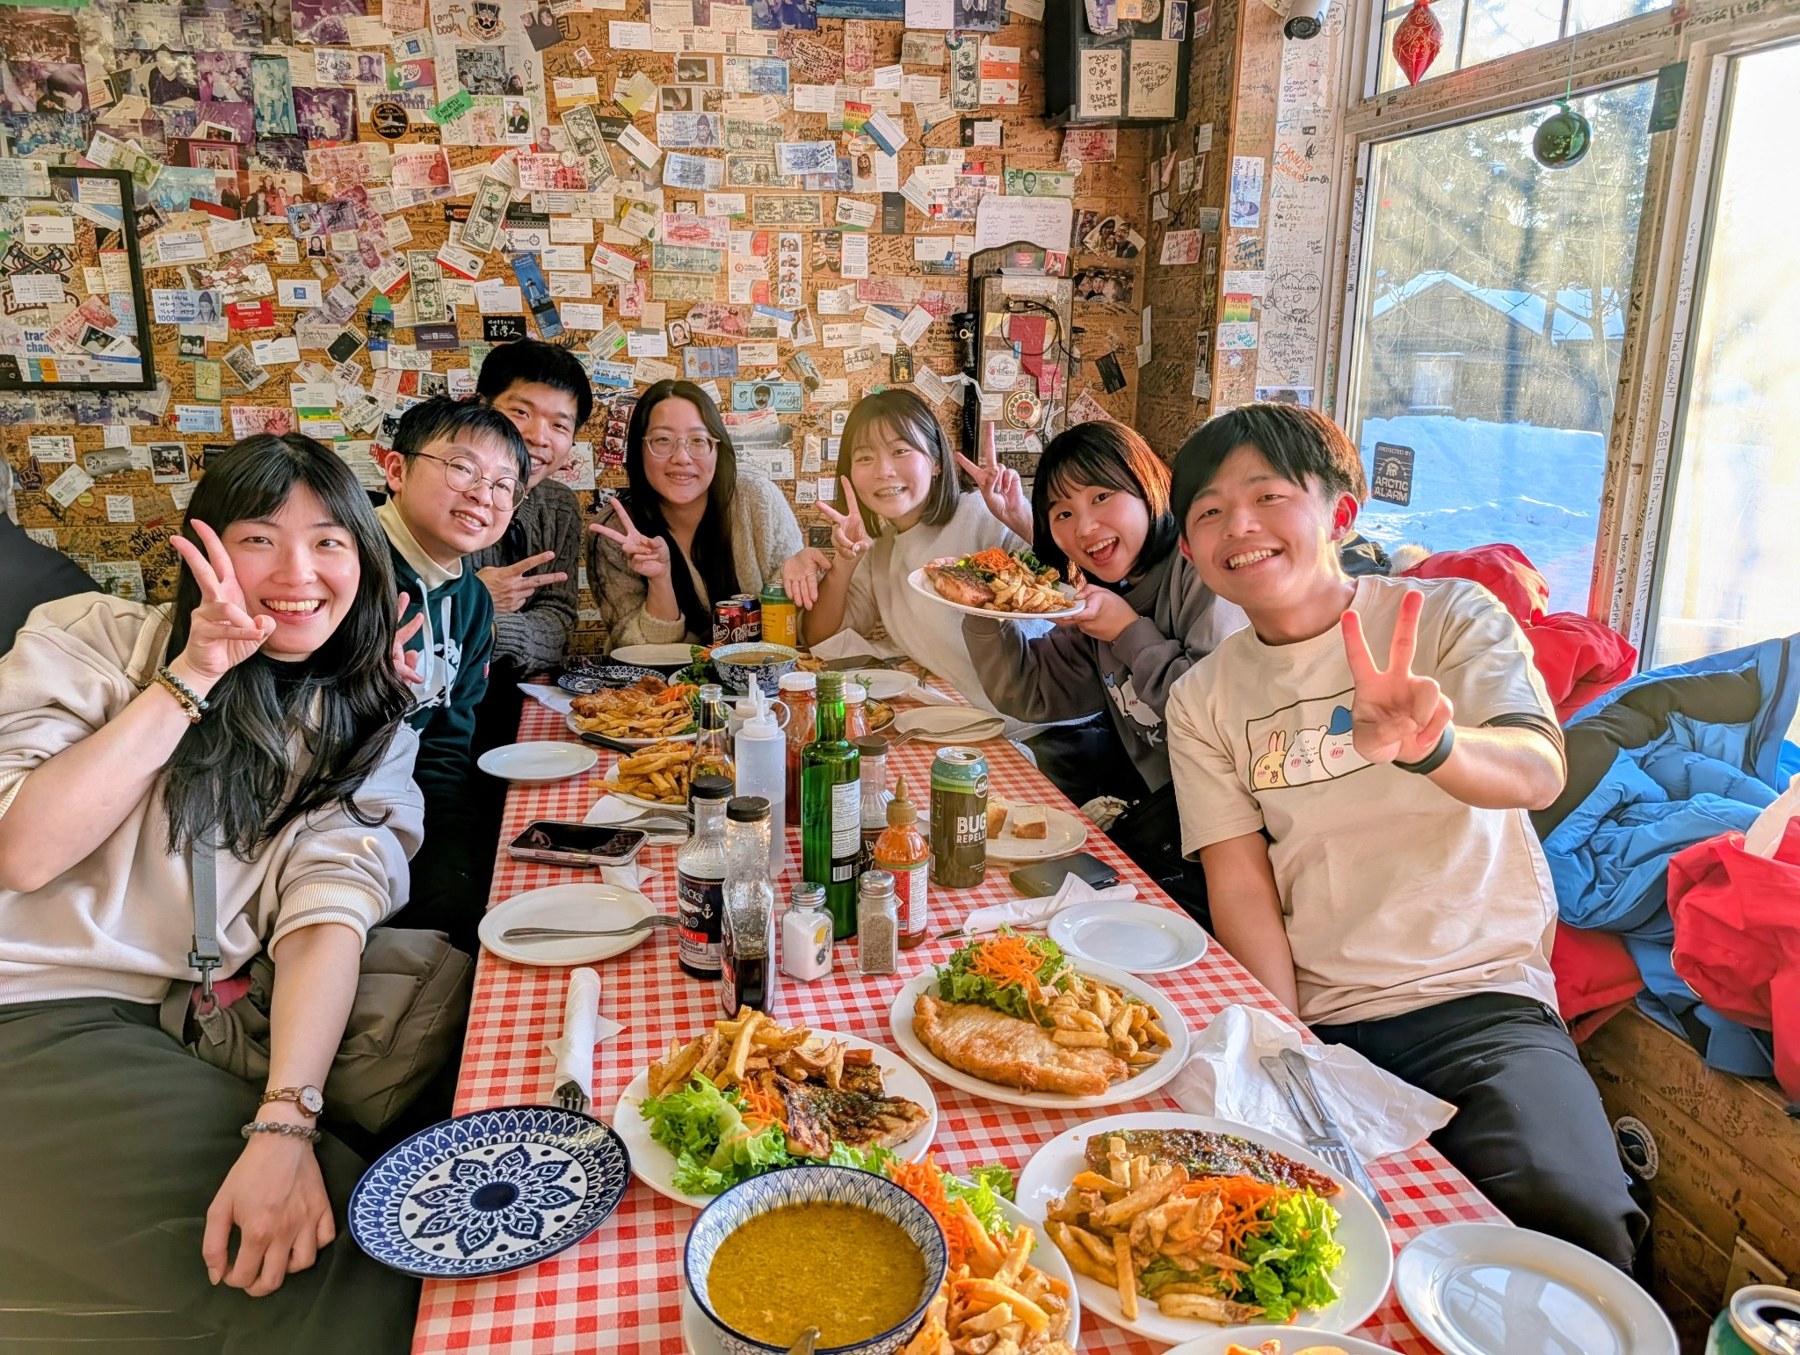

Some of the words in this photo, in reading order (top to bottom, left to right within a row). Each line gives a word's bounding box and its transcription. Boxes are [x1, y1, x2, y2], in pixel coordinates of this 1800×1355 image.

[726, 58, 737, 66] 20
[33, 162, 42, 171] 20
[1007, 171, 1016, 189] 200
[158, 315, 177, 323] 1000
[1656, 420, 1670, 456] ABEL
[1377, 446, 1405, 455] PROTECTED
[1652, 457, 1665, 491] CHEN
[1375, 475, 1409, 492] ARCTIC
[1373, 486, 1408, 502] ALARM
[957, 812, 986, 834] BUG
[1633, 1120, 1652, 1144] Survey
